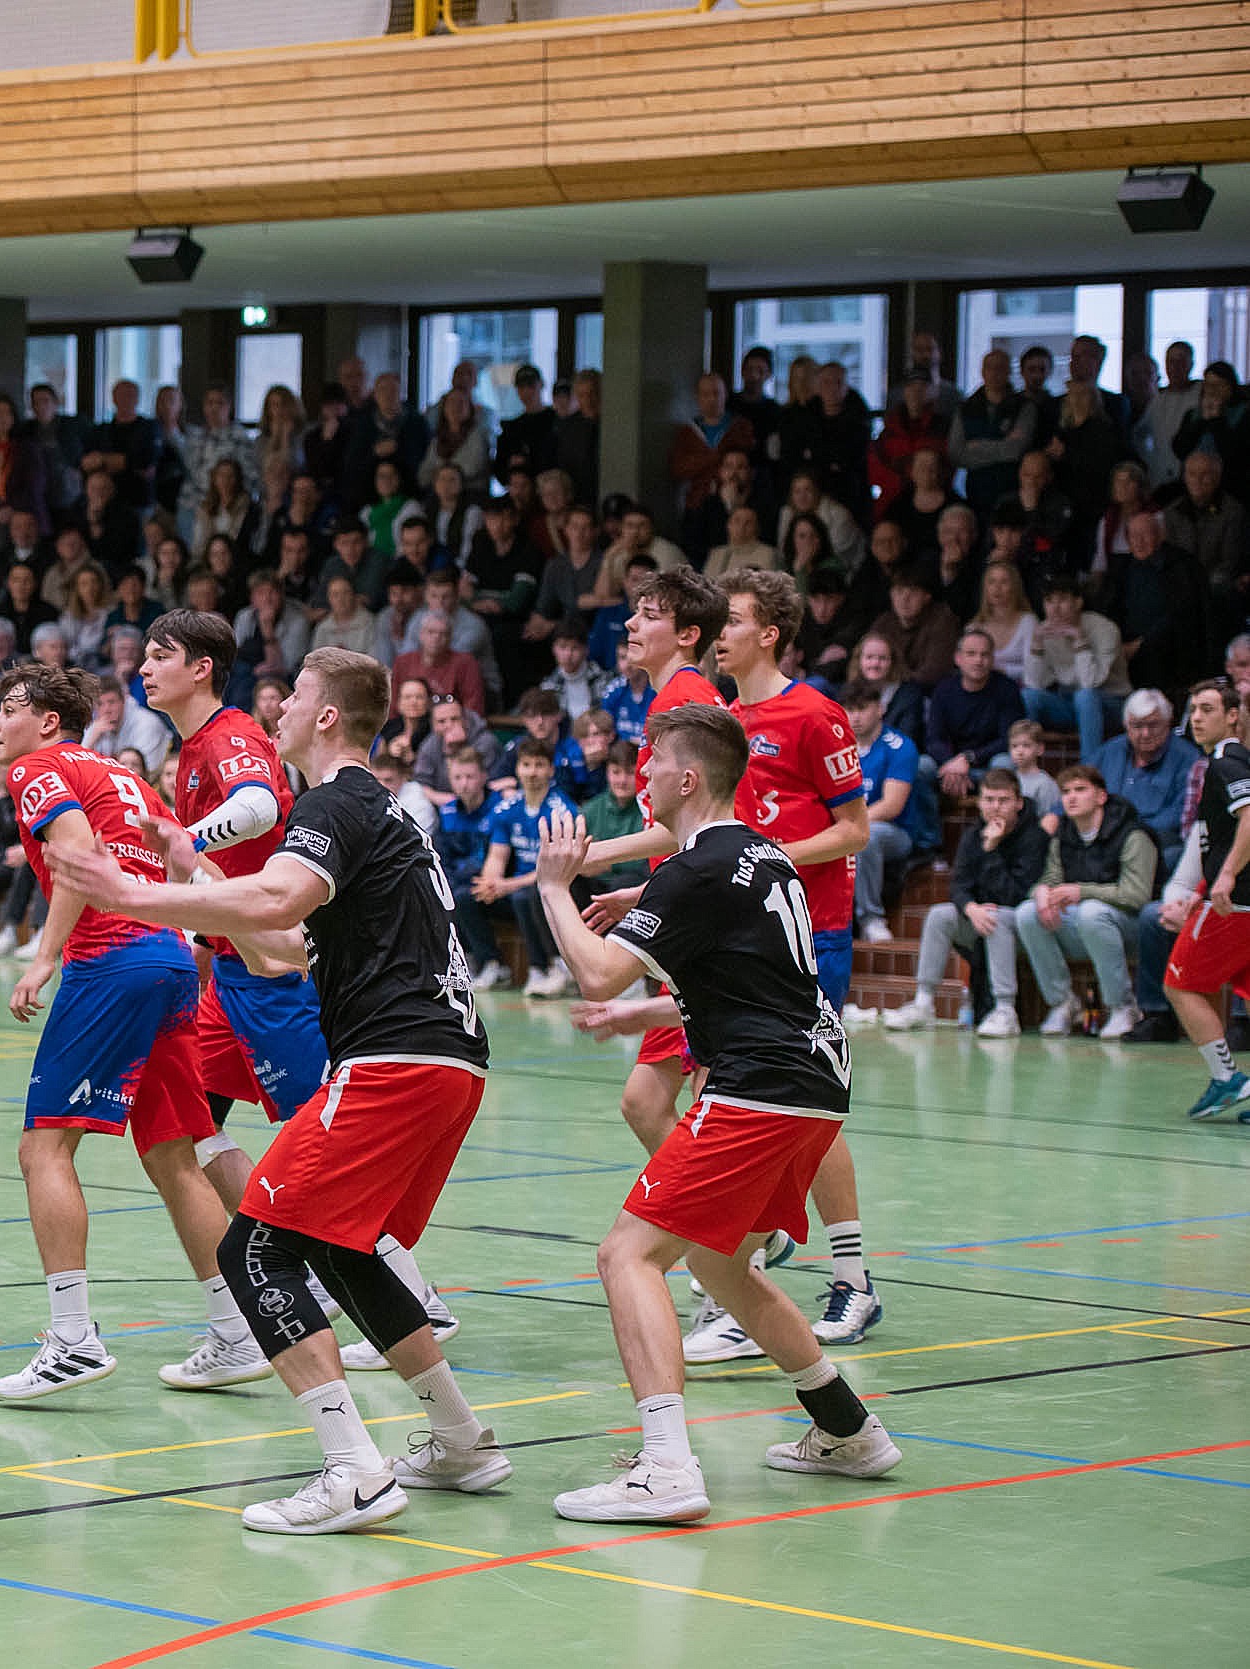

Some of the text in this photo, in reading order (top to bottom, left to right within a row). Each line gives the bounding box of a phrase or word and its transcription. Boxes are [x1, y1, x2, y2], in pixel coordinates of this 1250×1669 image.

[108, 772, 150, 829] 9
[731, 856, 755, 888] TuS
[763, 878, 819, 976] 10
